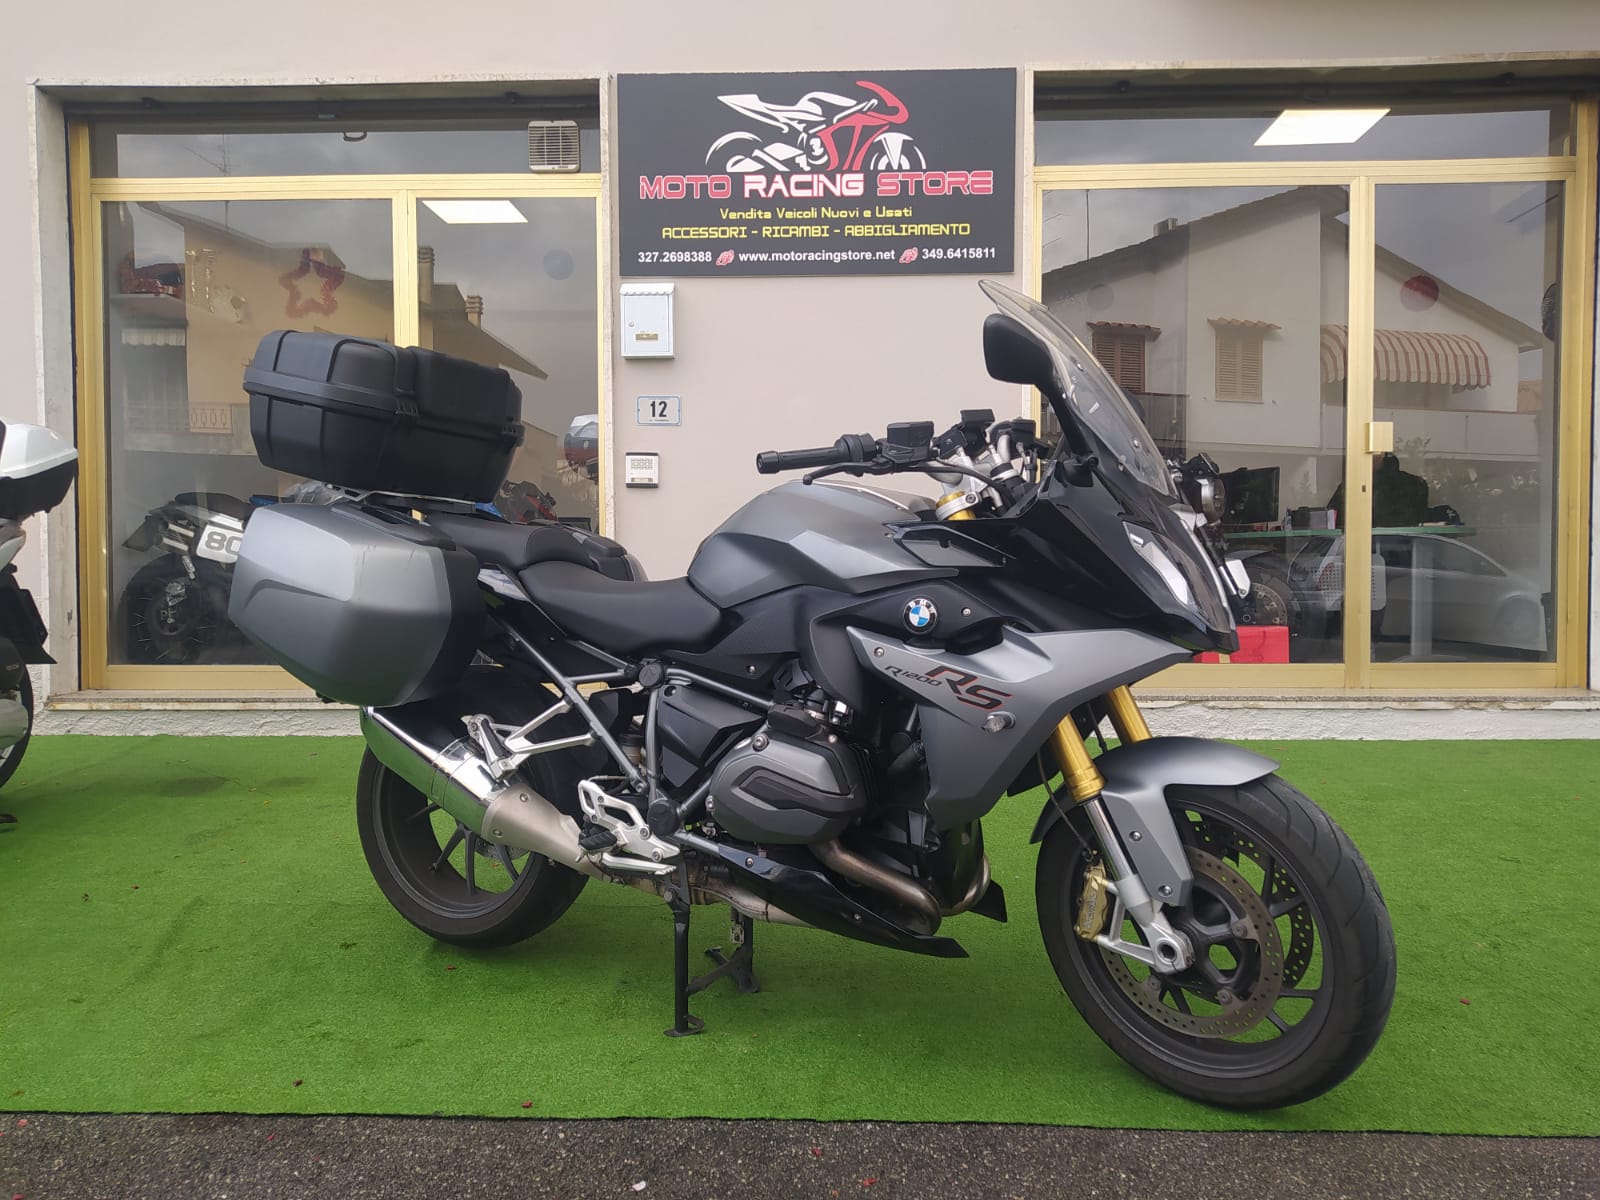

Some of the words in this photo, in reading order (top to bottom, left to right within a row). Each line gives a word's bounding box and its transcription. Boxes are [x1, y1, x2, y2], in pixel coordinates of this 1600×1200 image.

[640, 175, 731, 199] MOTO
[743, 173, 865, 198] RACING
[877, 170, 993, 196] STORE
[719, 207, 772, 220] Vendita
[776, 207, 818, 219] Veicoli
[821, 206, 859, 218] Nuovi
[875, 206, 913, 217] Usati
[662, 227, 747, 239] ACCESSORI
[762, 225, 830, 238] RICAMBI
[844, 223, 971, 237] ABBIGLIAMENTO
[638, 252, 712, 263] 327.2698388
[738, 250, 896, 263] www.motoracingstore.net
[921, 248, 996, 260] 349.6415811
[650, 401, 667, 418] 12
[925, 665, 1013, 710] RS
